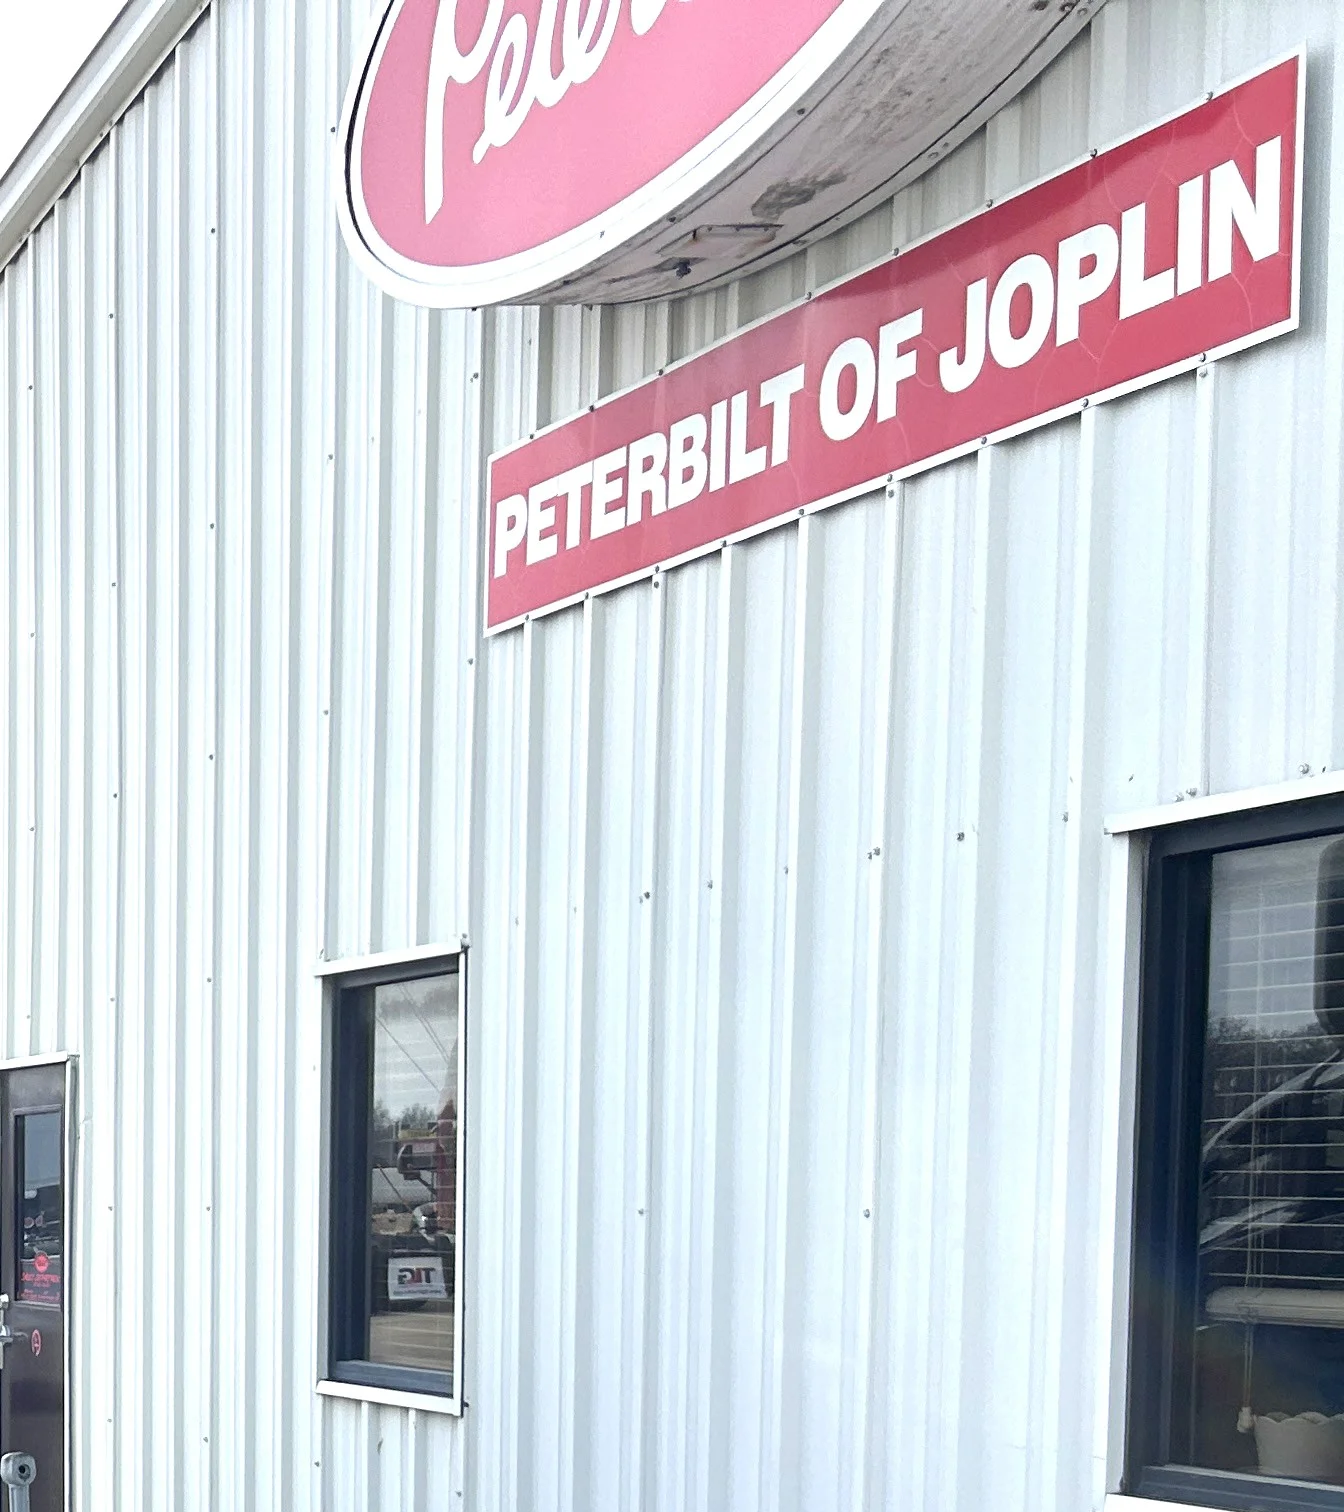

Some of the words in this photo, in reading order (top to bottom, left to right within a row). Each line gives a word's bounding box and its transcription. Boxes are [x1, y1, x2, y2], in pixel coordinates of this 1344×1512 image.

[493, 362, 804, 578] PETERBILT
[819, 309, 923, 442] OF
[939, 135, 1283, 394] JOPLIN
